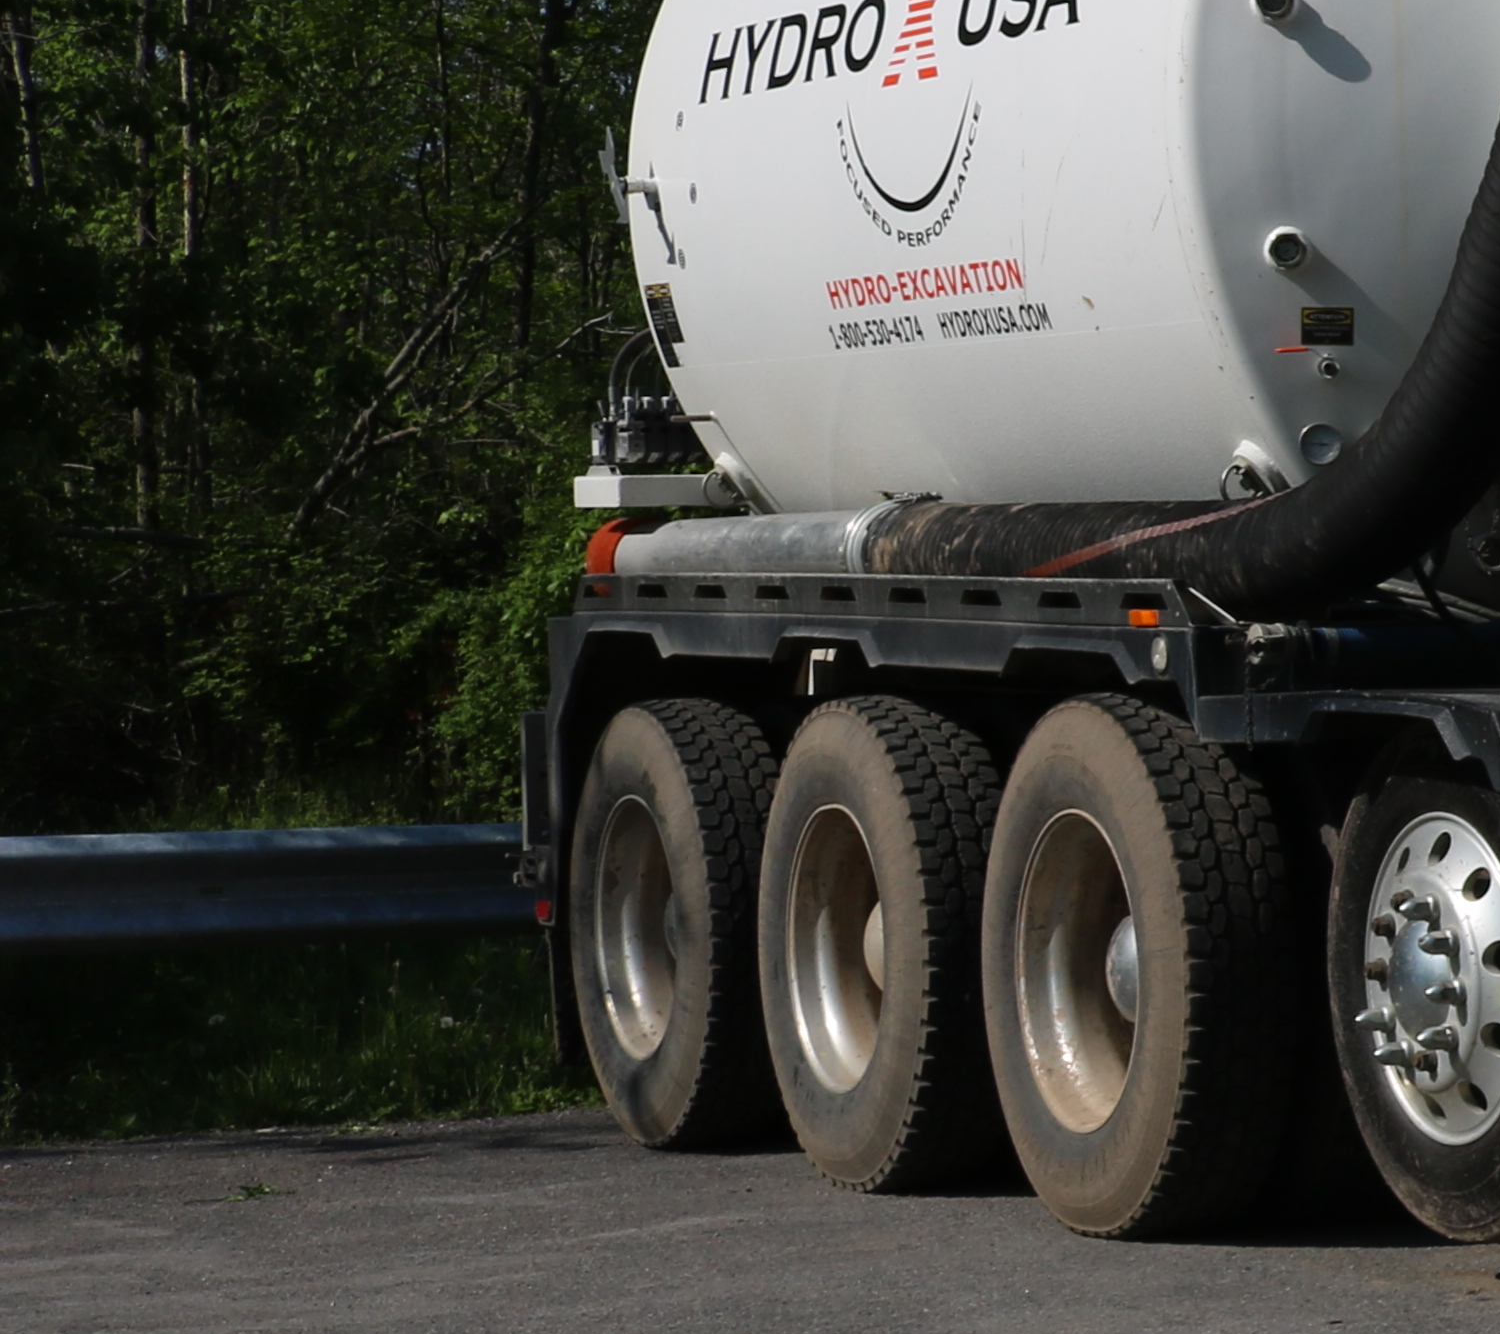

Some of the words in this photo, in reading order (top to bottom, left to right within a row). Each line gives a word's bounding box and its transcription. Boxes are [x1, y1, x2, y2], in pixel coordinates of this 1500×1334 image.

[836, 119, 892, 236] FOCUSED
[897, 100, 982, 247] PERFORMANCE
[826, 258, 1024, 309] HYDRO-EXCAVATION
[828, 315, 925, 349] 1-800-530-4174
[937, 303, 1053, 339] HYDROXUSA.COM
